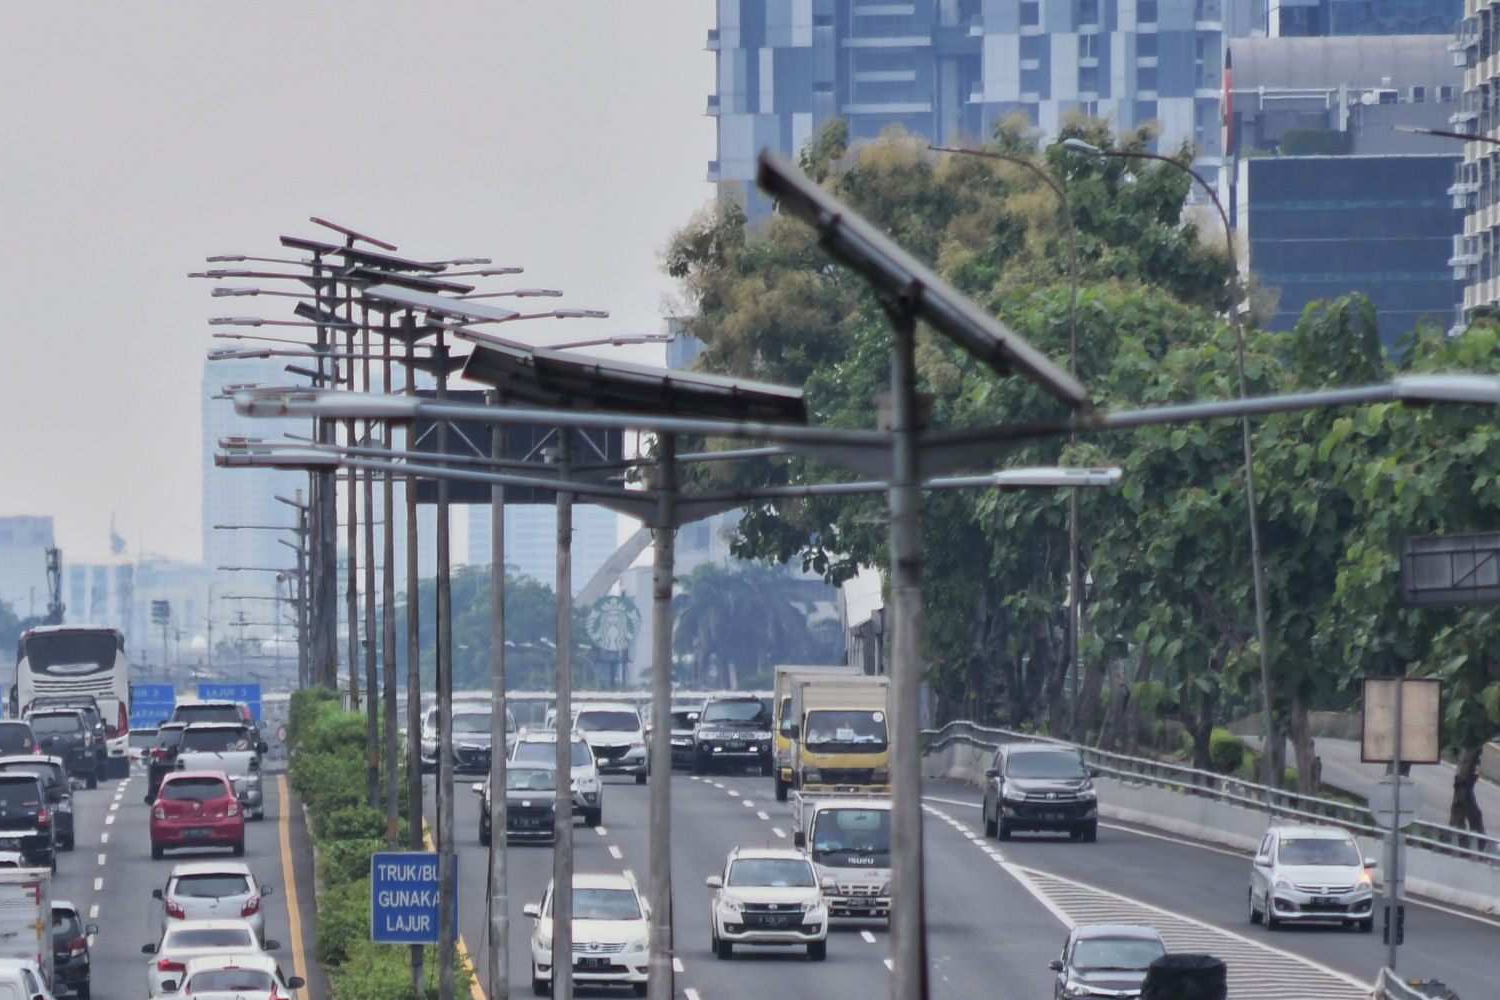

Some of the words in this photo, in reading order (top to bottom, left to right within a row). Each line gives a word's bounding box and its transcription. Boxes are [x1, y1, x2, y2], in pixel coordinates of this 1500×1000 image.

[378, 864, 439, 882] TRUK/BU
[378, 890, 439, 907] GUNAKA
[386, 915, 430, 931] LAJUR
